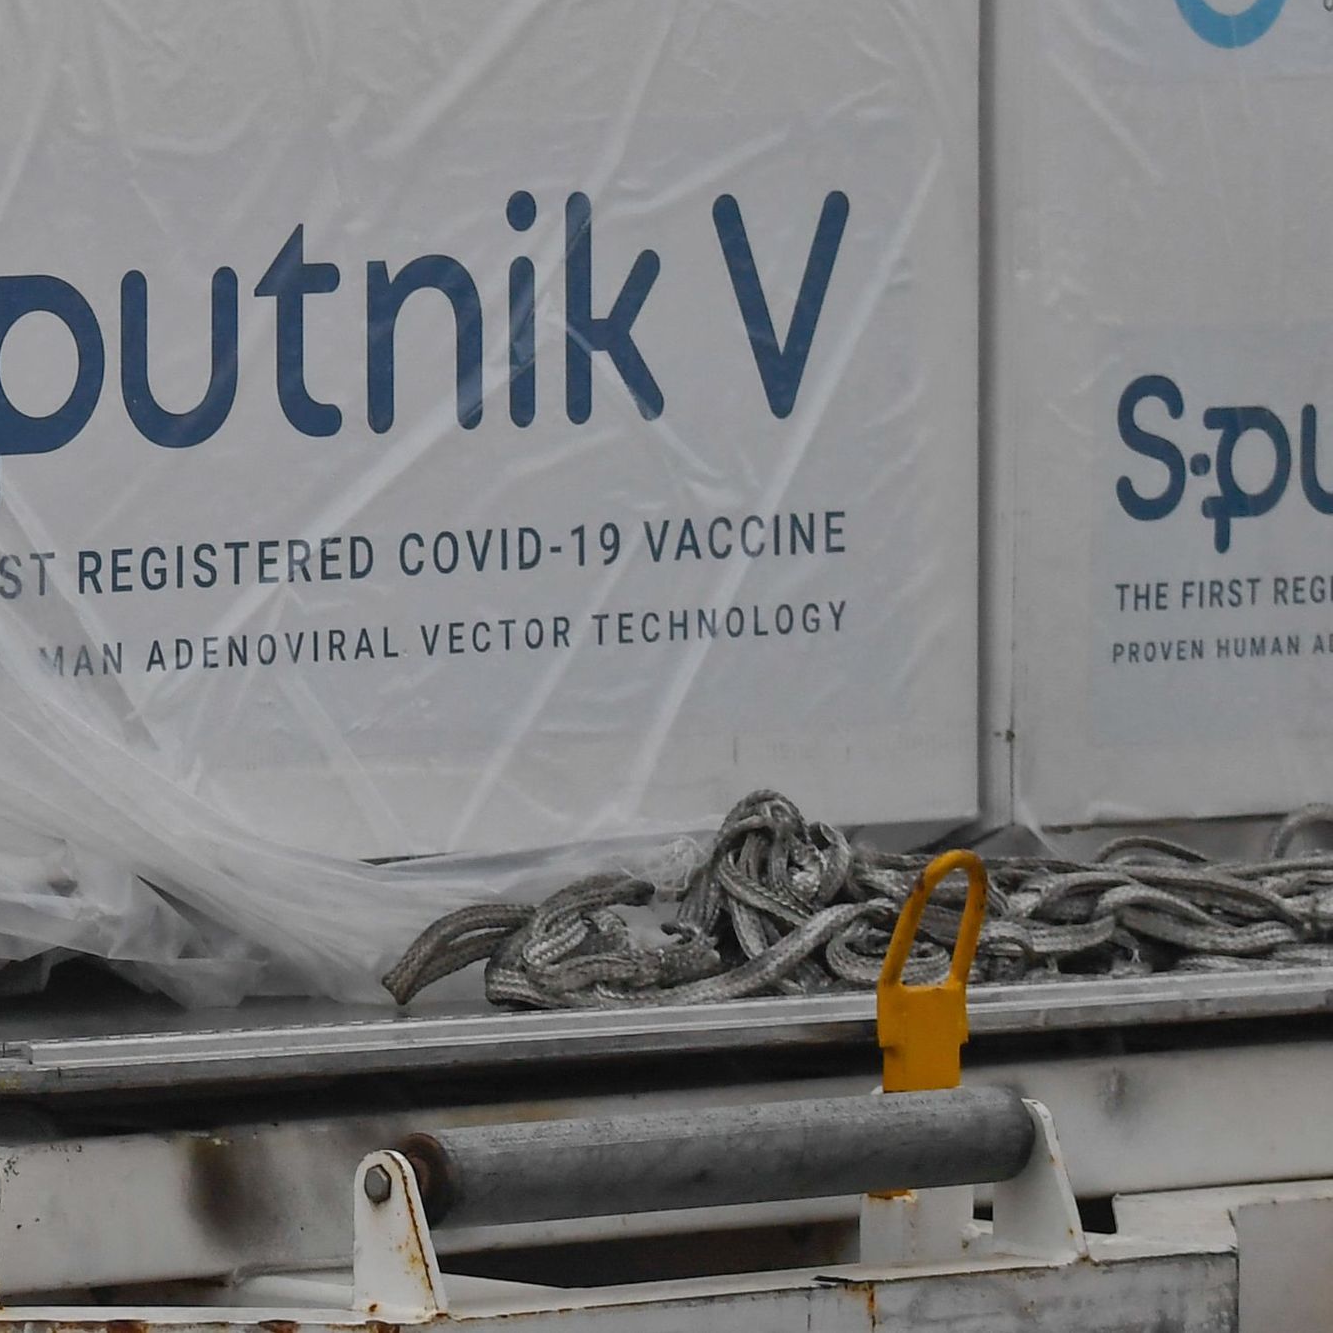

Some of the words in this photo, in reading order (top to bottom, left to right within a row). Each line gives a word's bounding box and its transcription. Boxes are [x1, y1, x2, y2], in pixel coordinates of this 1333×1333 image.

[710, 189, 851, 420] V
[78, 535, 374, 595] REGISTERED
[398, 522, 621, 576] COVID-19
[643, 510, 847, 563] VACCINE
[1115, 581, 1169, 612] THE
[1181, 577, 1262, 612] FIRST
[145, 626, 399, 673] ADENOVIRAL
[420, 616, 571, 657] VECTOR
[590, 600, 847, 646] TECHNOLOGY
[1112, 639, 1204, 664] PROVEN
[1216, 635, 1301, 659] HUMAN
